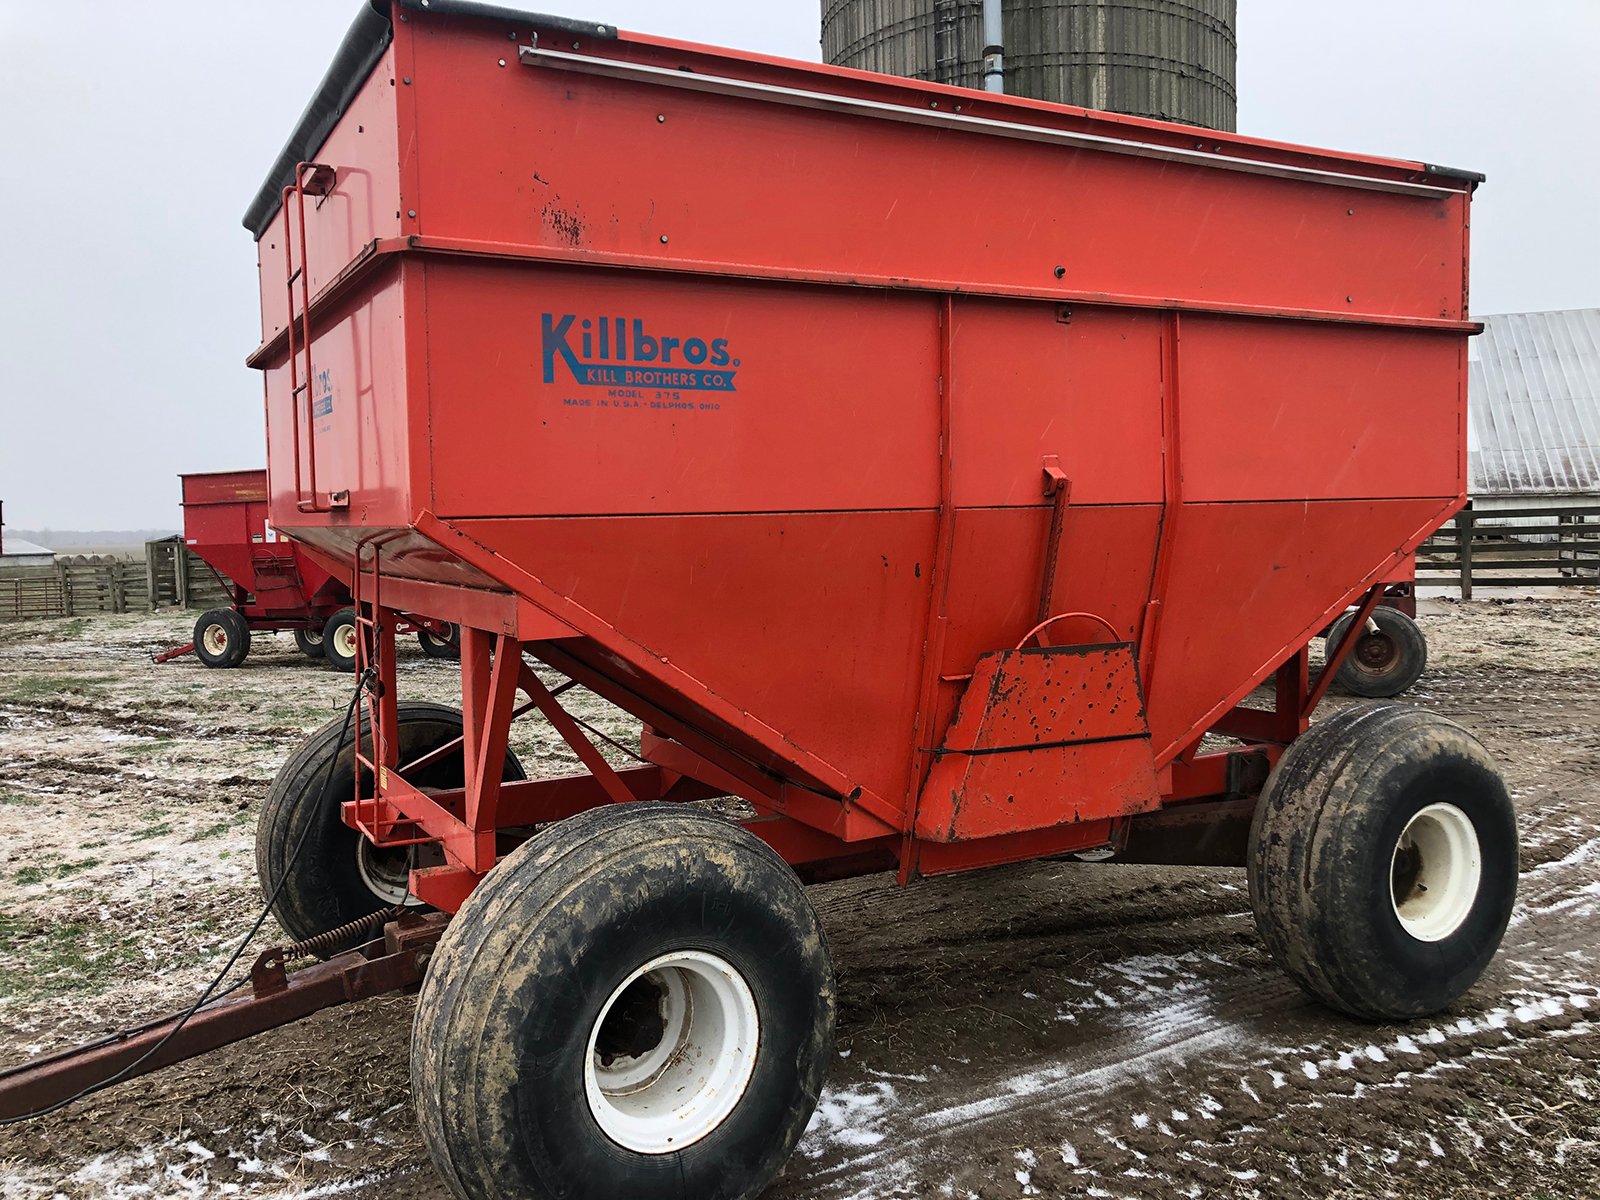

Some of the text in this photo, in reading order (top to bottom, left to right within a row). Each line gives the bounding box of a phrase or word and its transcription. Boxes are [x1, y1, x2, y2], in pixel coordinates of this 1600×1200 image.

[587, 369, 727, 388] KILL BROTHERS CO.
[608, 389, 680, 400] MODEL 375
[563, 399, 591, 407] MADE
[699, 403, 720, 411] OHIO
